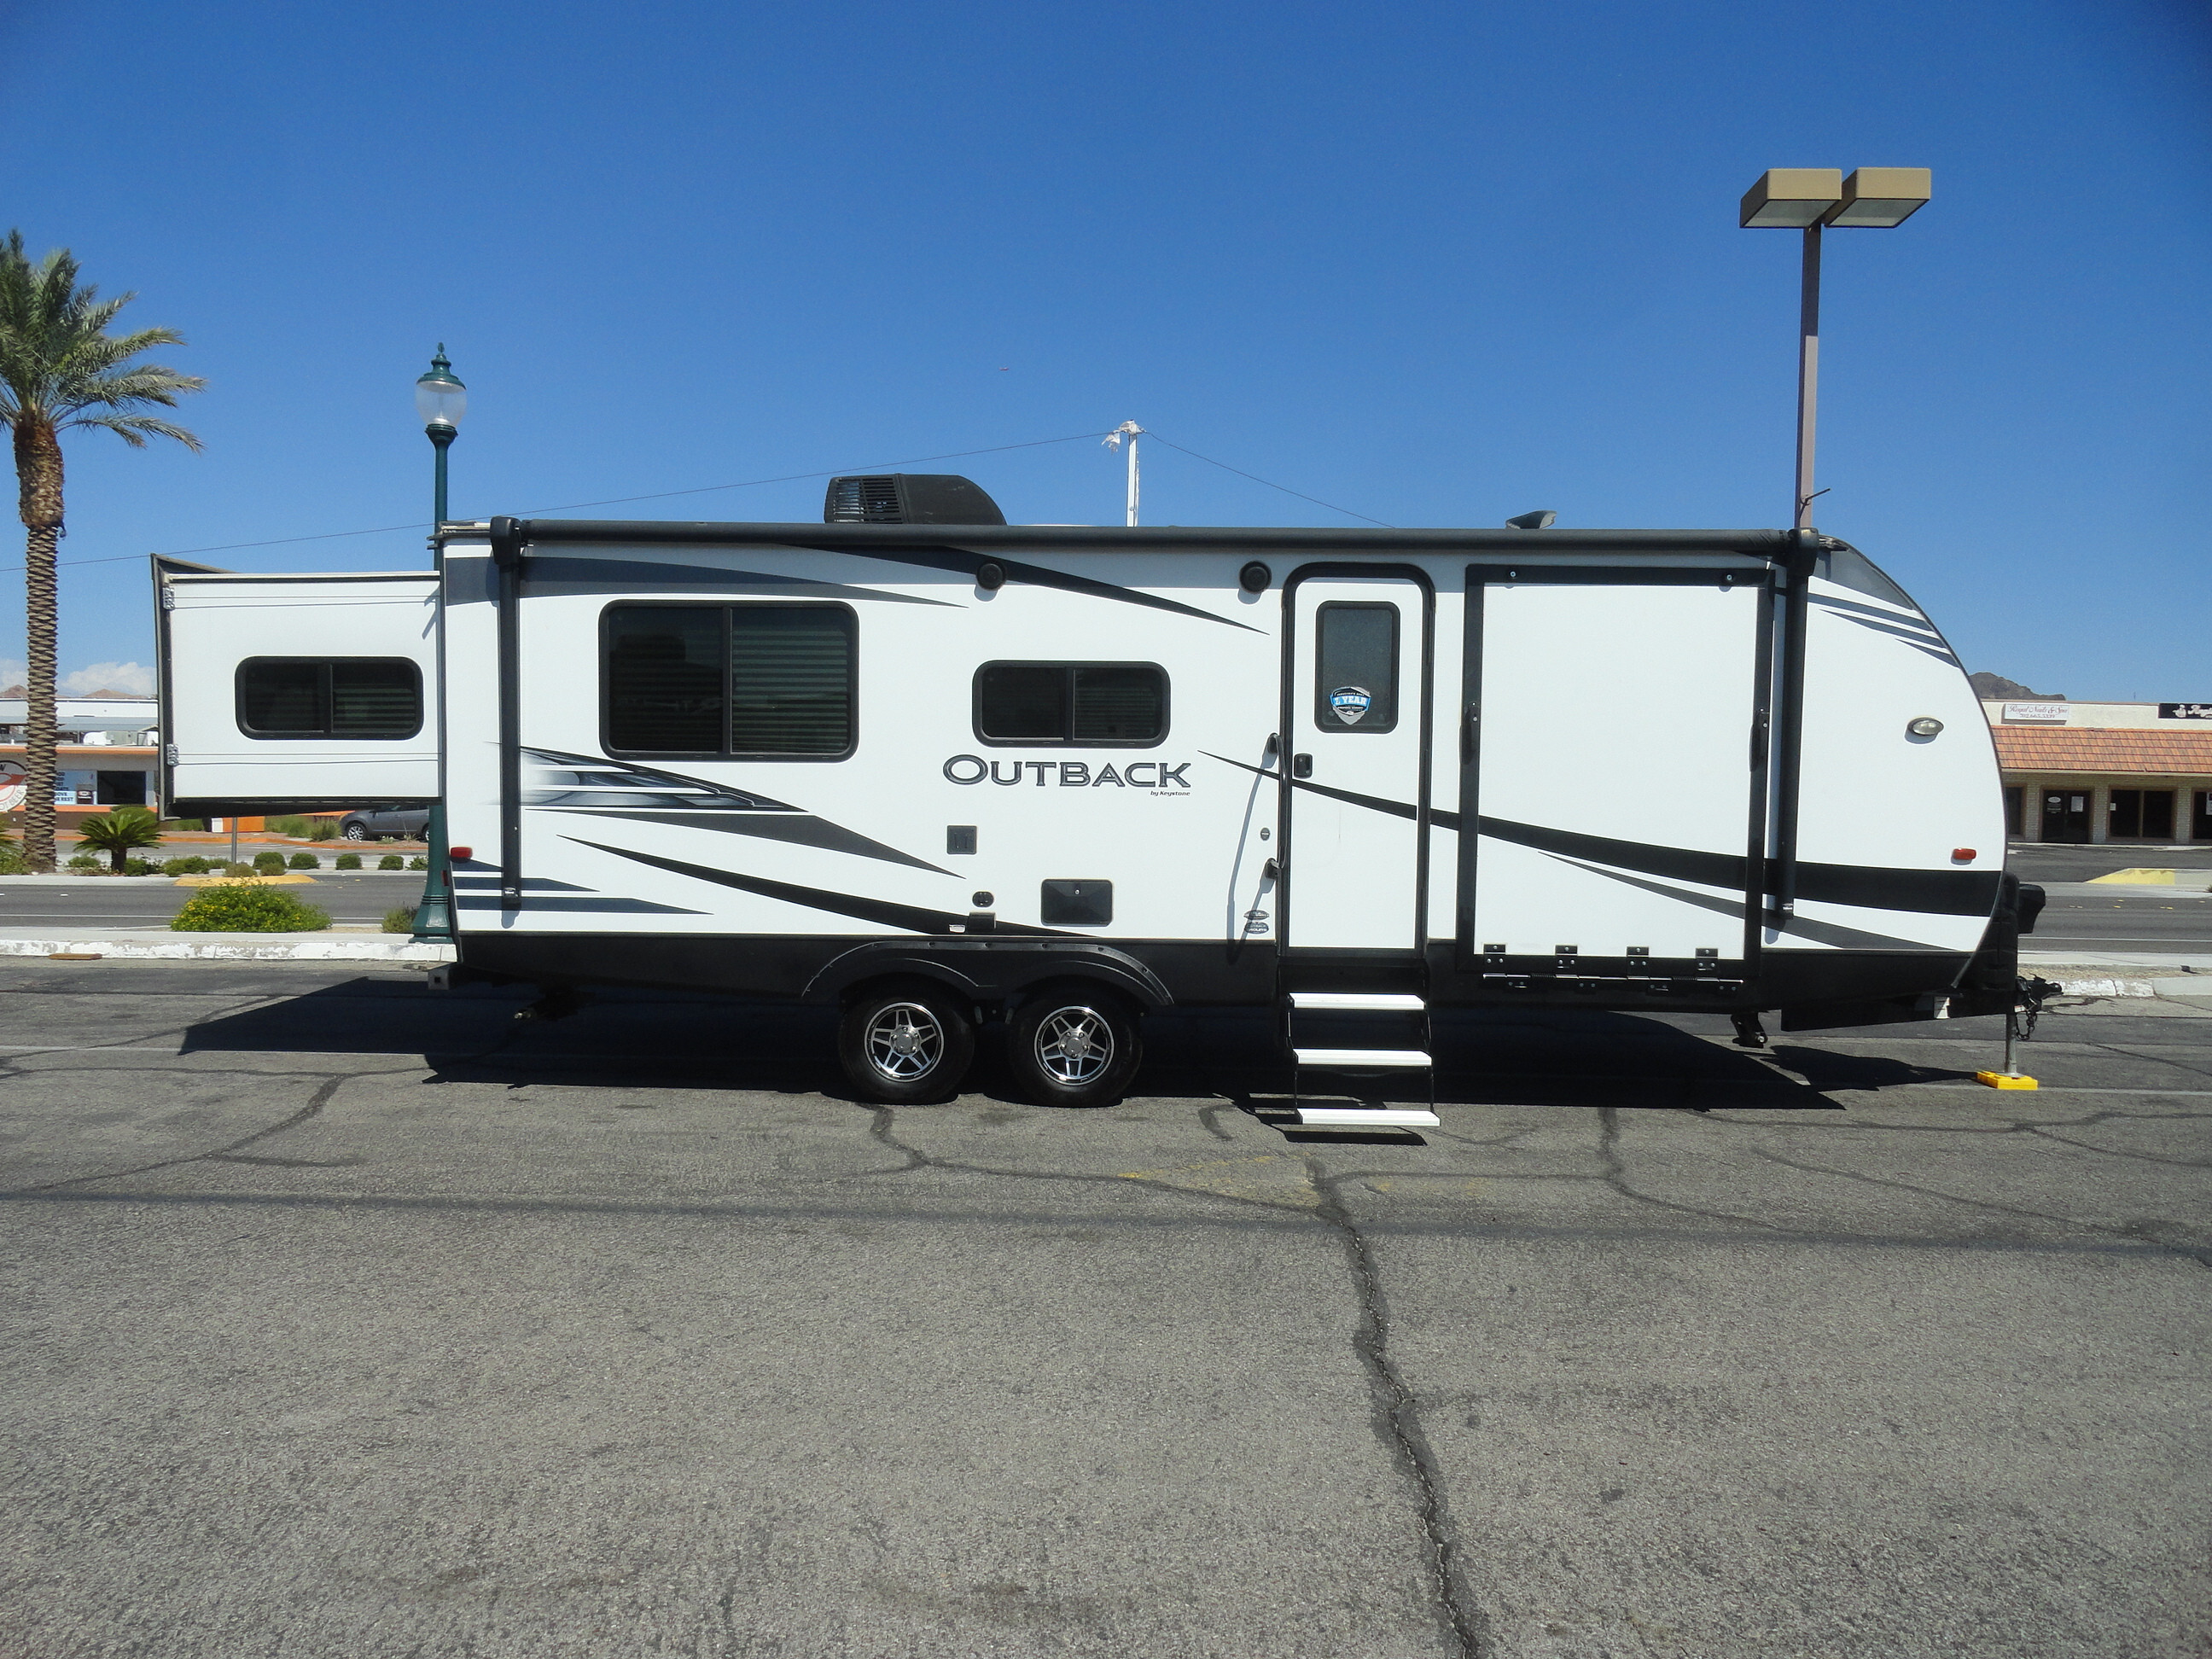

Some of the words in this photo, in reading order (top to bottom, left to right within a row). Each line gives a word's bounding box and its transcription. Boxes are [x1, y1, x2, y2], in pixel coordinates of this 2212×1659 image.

[1342, 696, 1366, 705] YEAR
[2007, 705, 2029, 713] Royal
[2054, 706, 2069, 715] Spa
[943, 754, 1191, 788] OUTBACK
[9, 789, 25, 806] BEER
